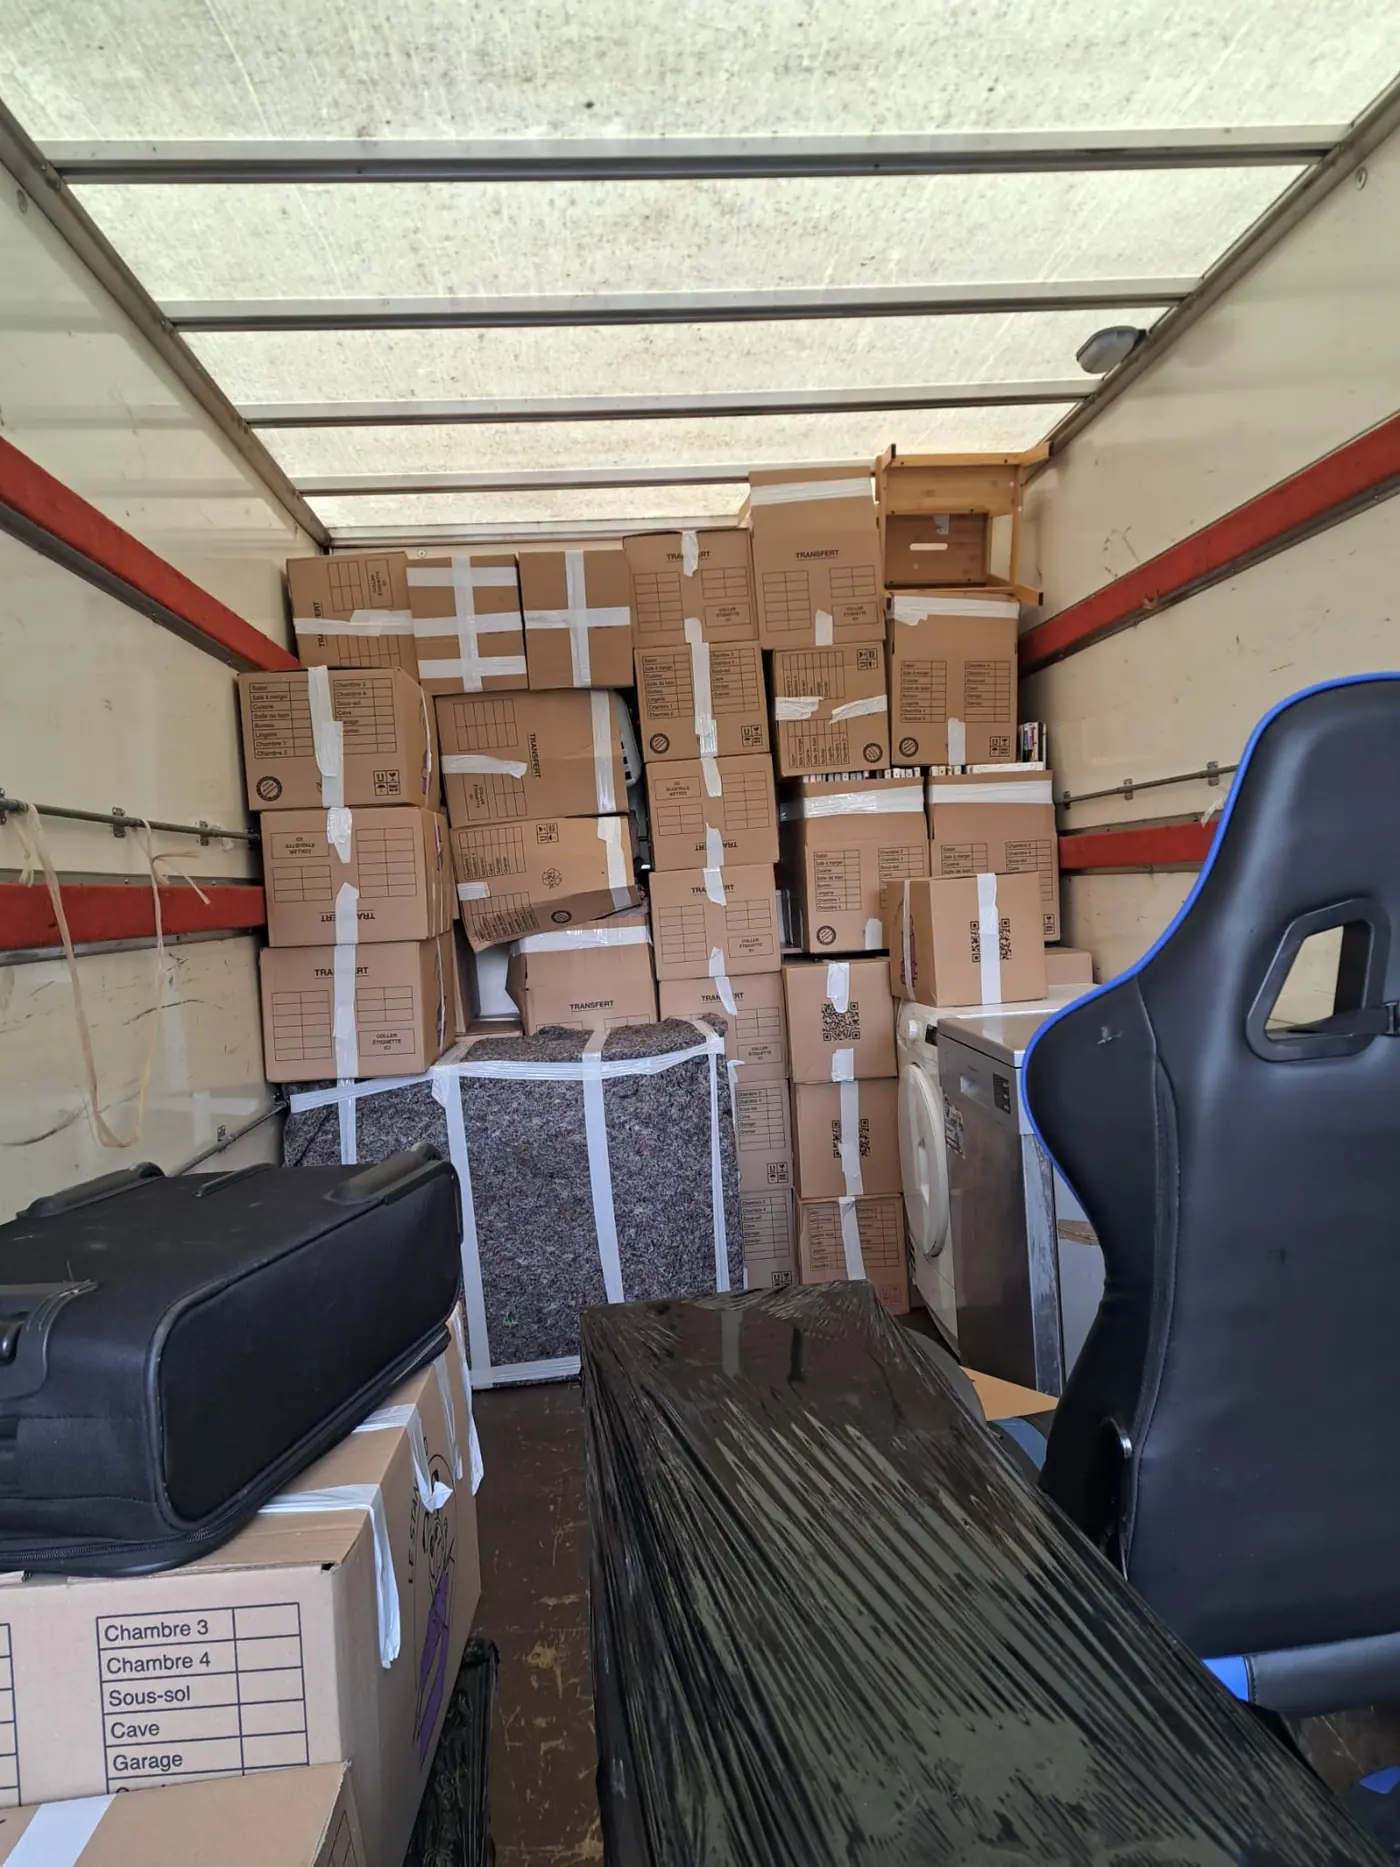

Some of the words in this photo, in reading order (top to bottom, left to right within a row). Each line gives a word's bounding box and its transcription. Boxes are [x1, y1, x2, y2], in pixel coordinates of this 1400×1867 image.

[796, 549, 839, 559] TRANSFERT
[529, 733, 541, 778] TRANSFERT
[570, 1000, 614, 1010] TRANSFERT
[103, 1620, 192, 1643] Chambre
[196, 1618, 210, 1637] 3
[105, 1652, 194, 1675] Chambre
[198, 1651, 212, 1668] 4
[108, 1685, 192, 1708] Sous-sol
[110, 1721, 161, 1740] Cave
[112, 1751, 184, 1775] Garage
